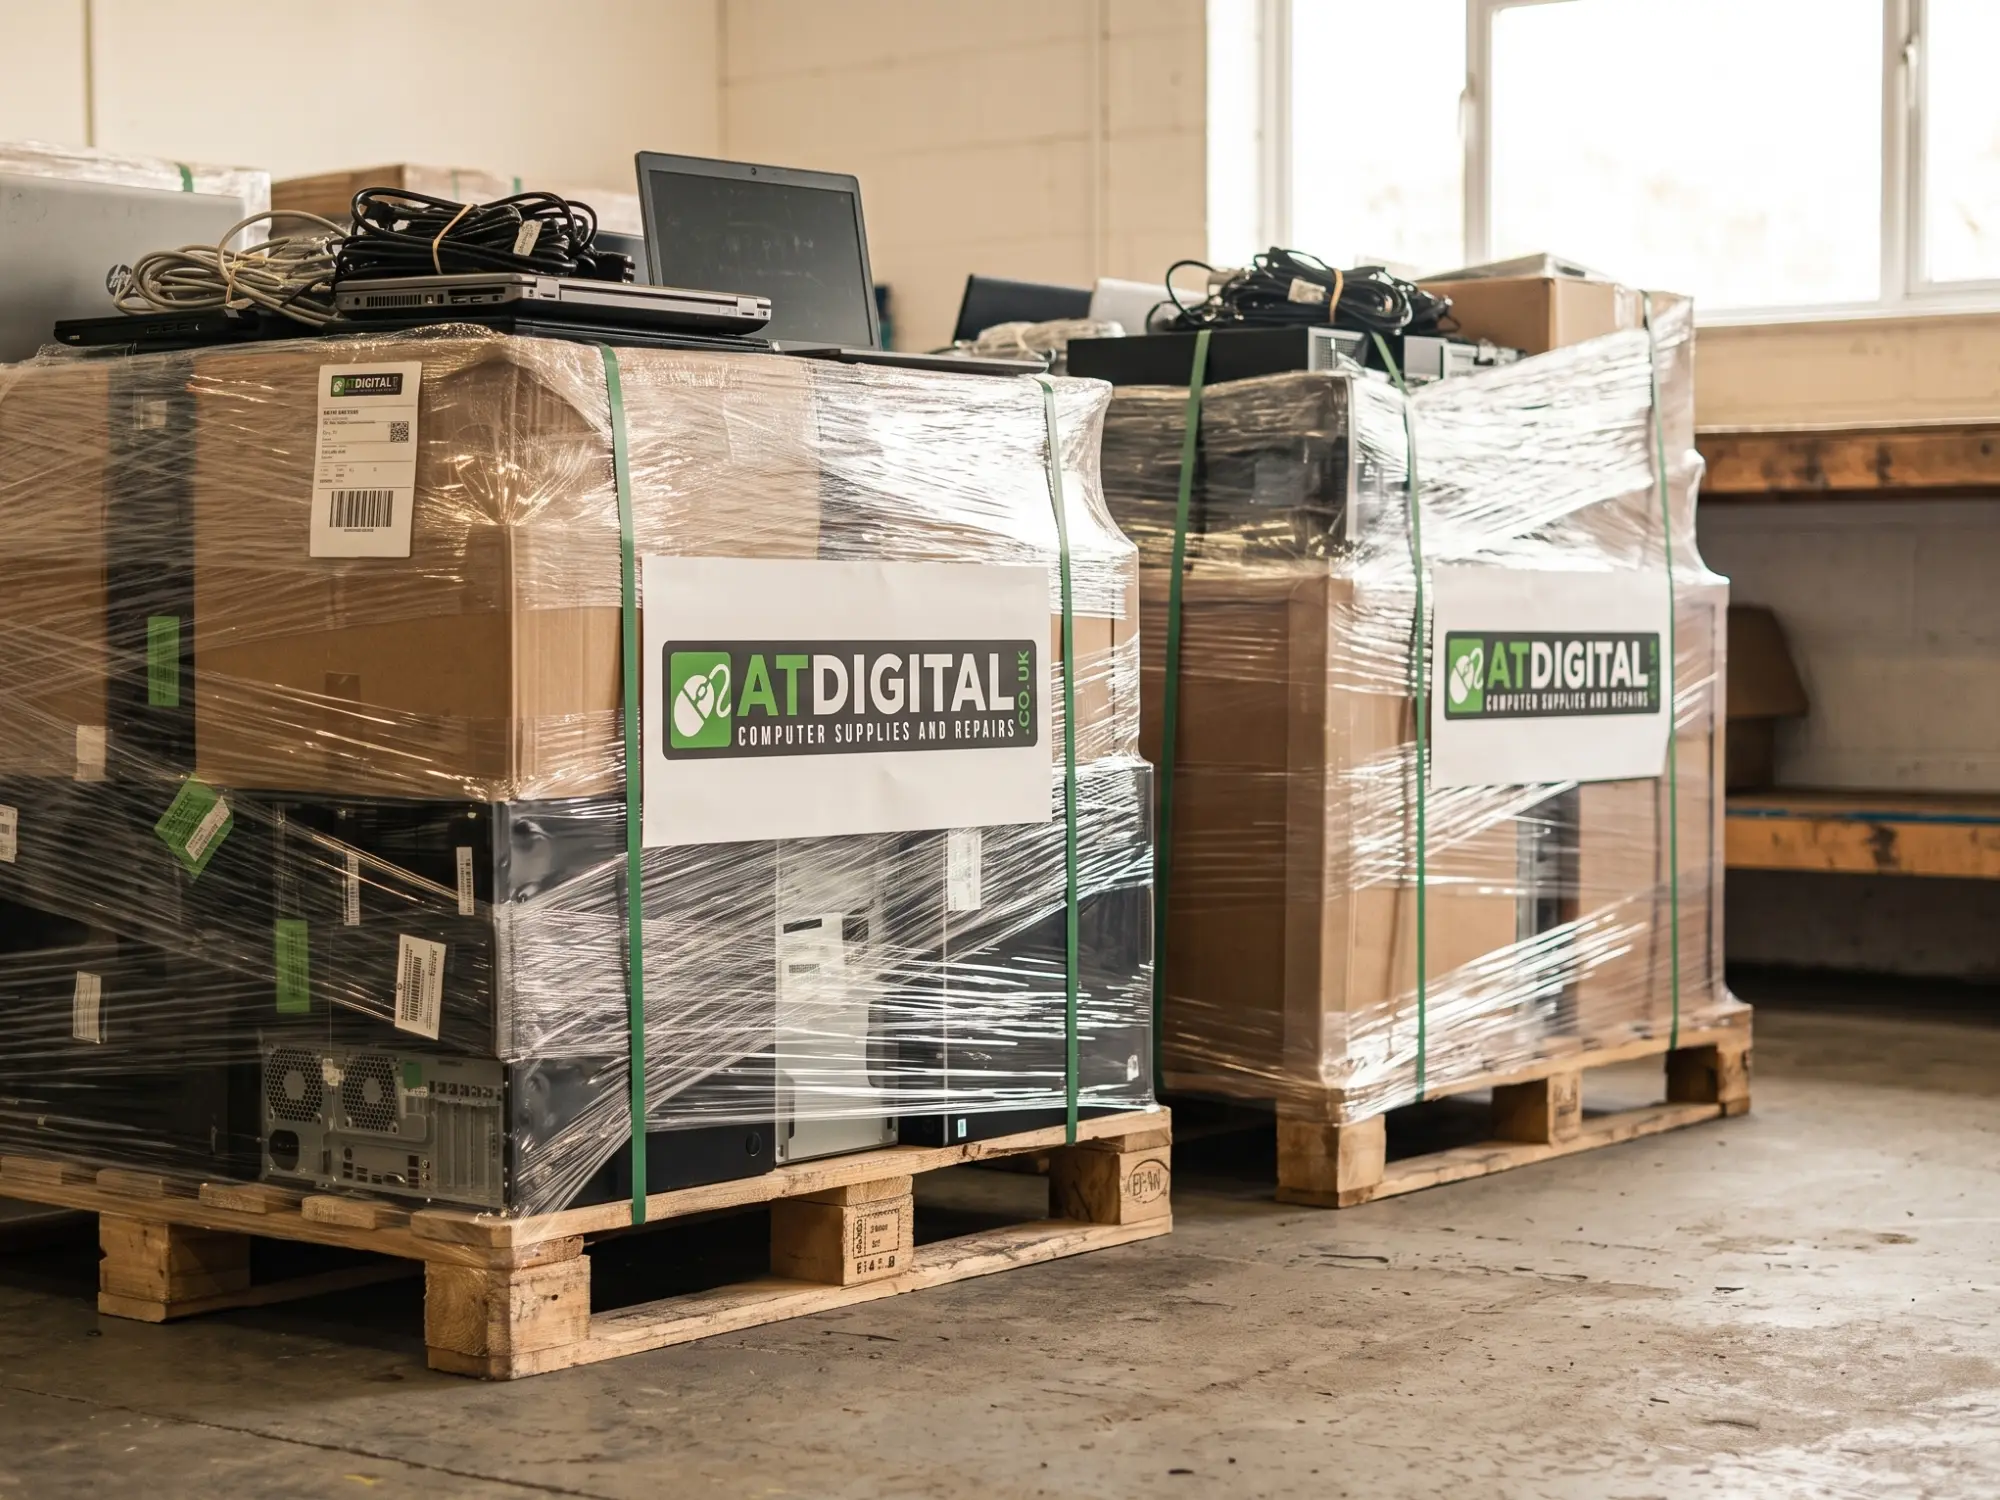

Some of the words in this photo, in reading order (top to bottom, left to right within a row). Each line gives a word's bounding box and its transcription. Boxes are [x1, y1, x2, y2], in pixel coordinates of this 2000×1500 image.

[1486, 693, 1538, 712] COMPUTER
[1541, 692, 1586, 710] SUPPLIES
[1590, 691, 1608, 709] AND
[1611, 690, 1648, 708] REPAIRS
[738, 724, 826, 747] COMPUTER
[834, 721, 910, 744] SUPPLIES
[918, 719, 946, 741] AND
[954, 718, 1015, 740] REPAIRS
